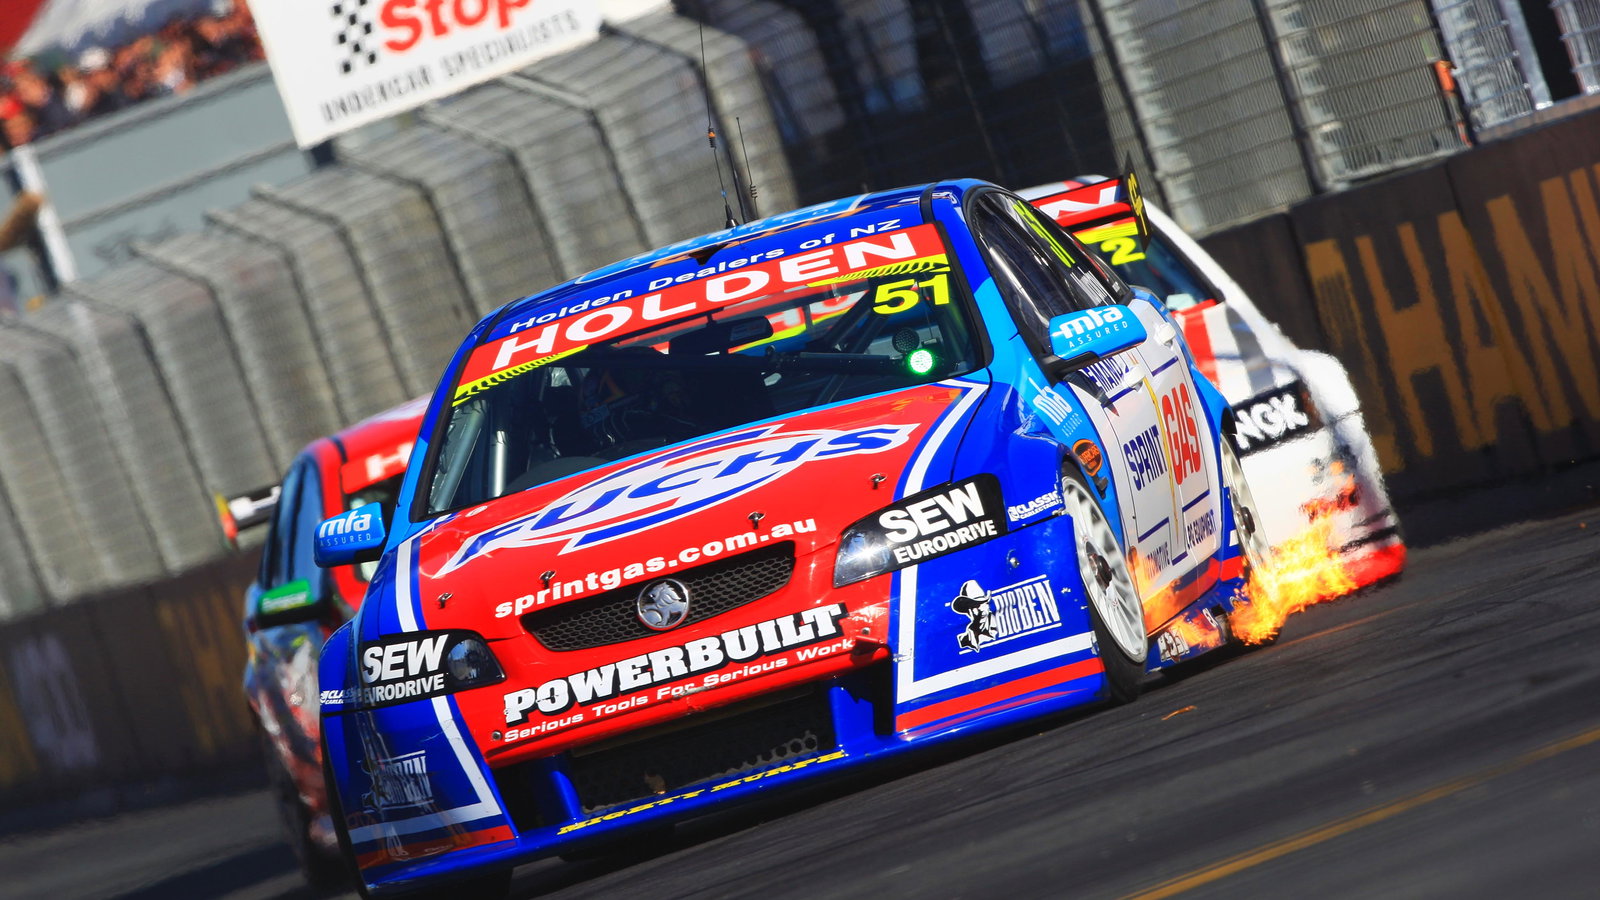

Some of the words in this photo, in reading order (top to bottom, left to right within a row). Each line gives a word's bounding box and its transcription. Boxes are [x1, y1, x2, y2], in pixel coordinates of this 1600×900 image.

[379, 0, 537, 54] Stop
[490, 231, 918, 371] HOLDEN
[509, 288, 633, 334] Holden
[647, 247, 786, 292] Dealers
[798, 232, 837, 251] of
[849, 217, 902, 239] NZ
[873, 273, 950, 316] 51
[1068, 320, 1129, 348] ASSURED
[1161, 382, 1201, 485] GAS
[1233, 393, 1309, 450] NGK
[1123, 424, 1168, 491] SPRINT
[449, 424, 912, 570] FUCHS
[879, 482, 986, 544] SEW
[320, 533, 371, 548] ASSURED
[494, 517, 817, 619] sprintgas.com.au
[893, 519, 998, 565] EURODRIVE
[362, 633, 449, 684] SEW
[364, 672, 445, 703] EURODRIVE
[503, 603, 844, 725] POWERBUILT
[504, 712, 584, 742] Serious
[592, 695, 649, 718] Tools
[656, 683, 696, 701] For
[703, 657, 789, 684] Serious
[795, 638, 855, 663] Work
